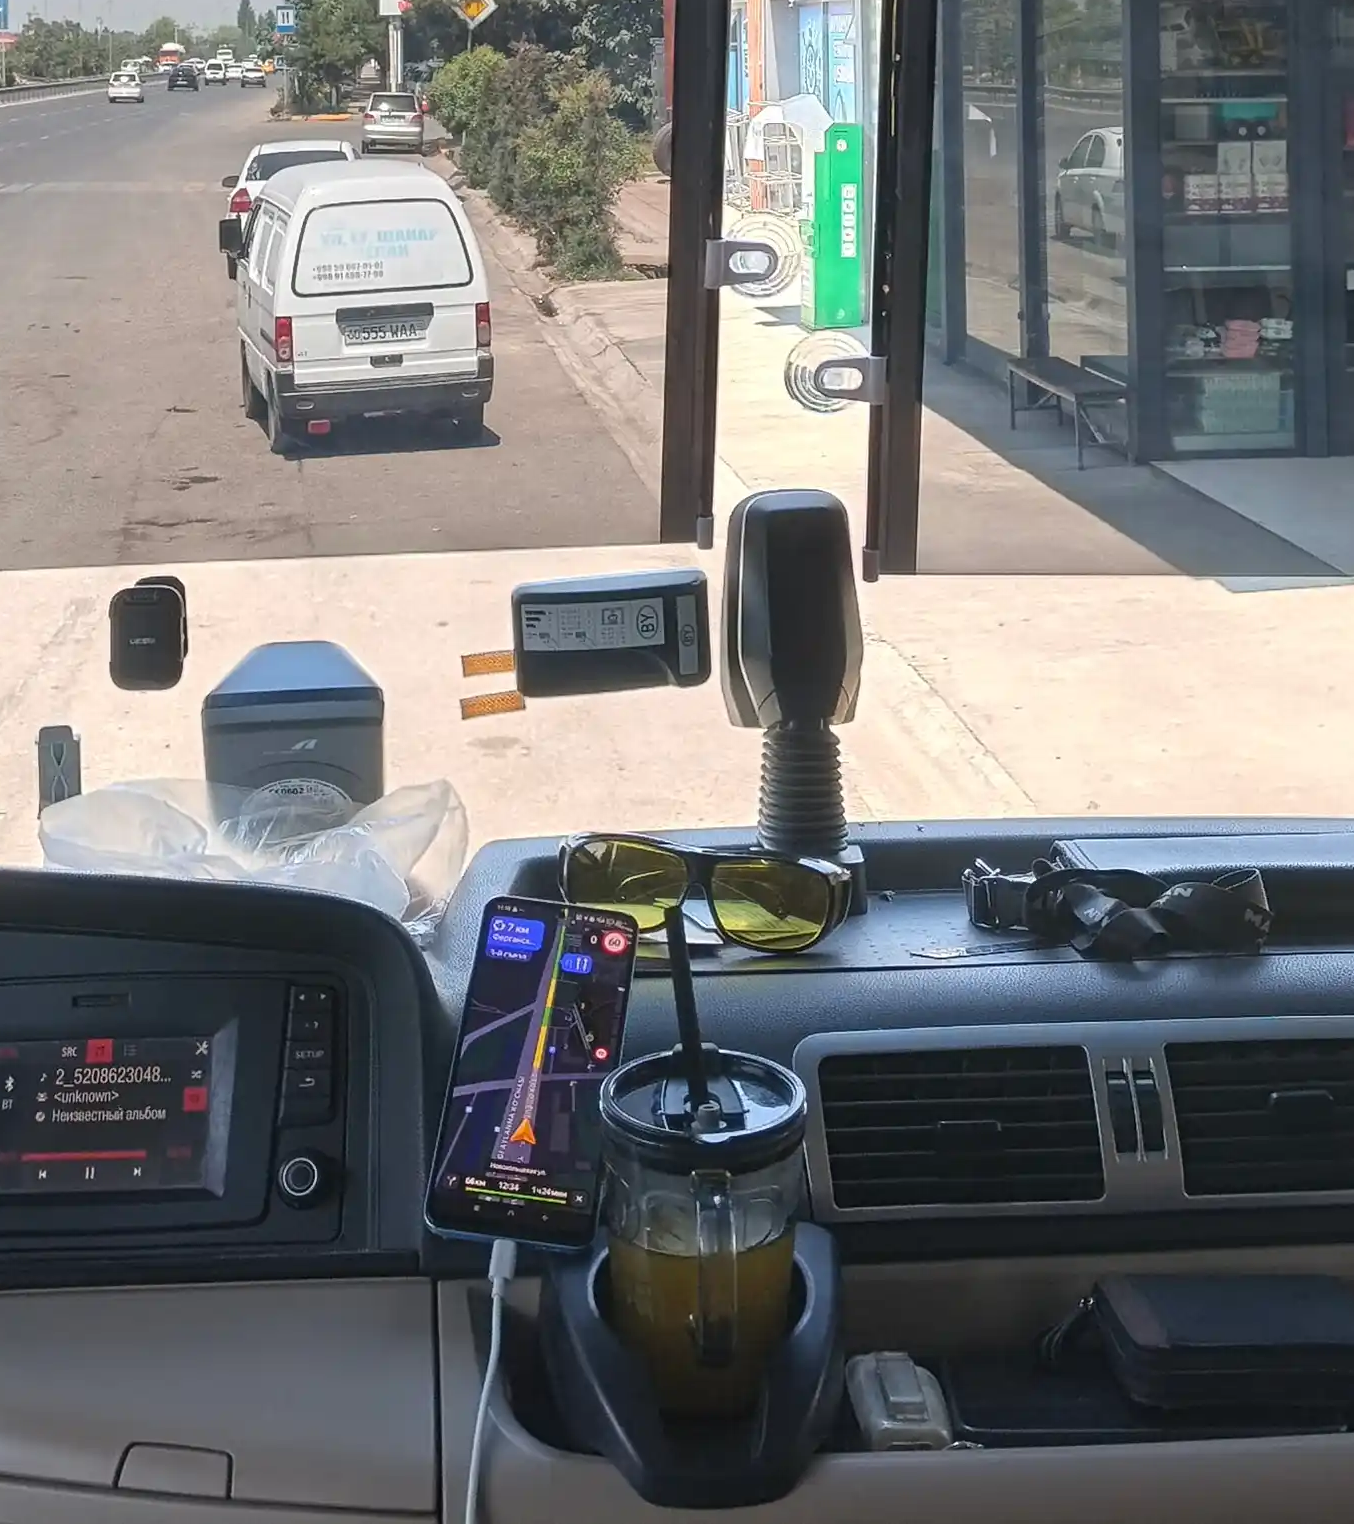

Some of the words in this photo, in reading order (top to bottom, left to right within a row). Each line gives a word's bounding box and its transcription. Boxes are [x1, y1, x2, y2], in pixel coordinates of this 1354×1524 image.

[362, 325, 387, 340] 555
[389, 323, 418, 338] WAA
[640, 613, 655, 632] BY
[507, 922, 514, 933] 7
[590, 935, 598, 945] 0
[608, 935, 622, 948] 60
[61, 1046, 78, 1058] SRC
[55, 1066, 172, 1088] 2_5208623048...
[53, 1090, 120, 1104] <unknown>
[1, 1099, 14, 1110] BT
[52, 1107, 124, 1123] Неизвестный
[125, 1107, 167, 1121] альбом
